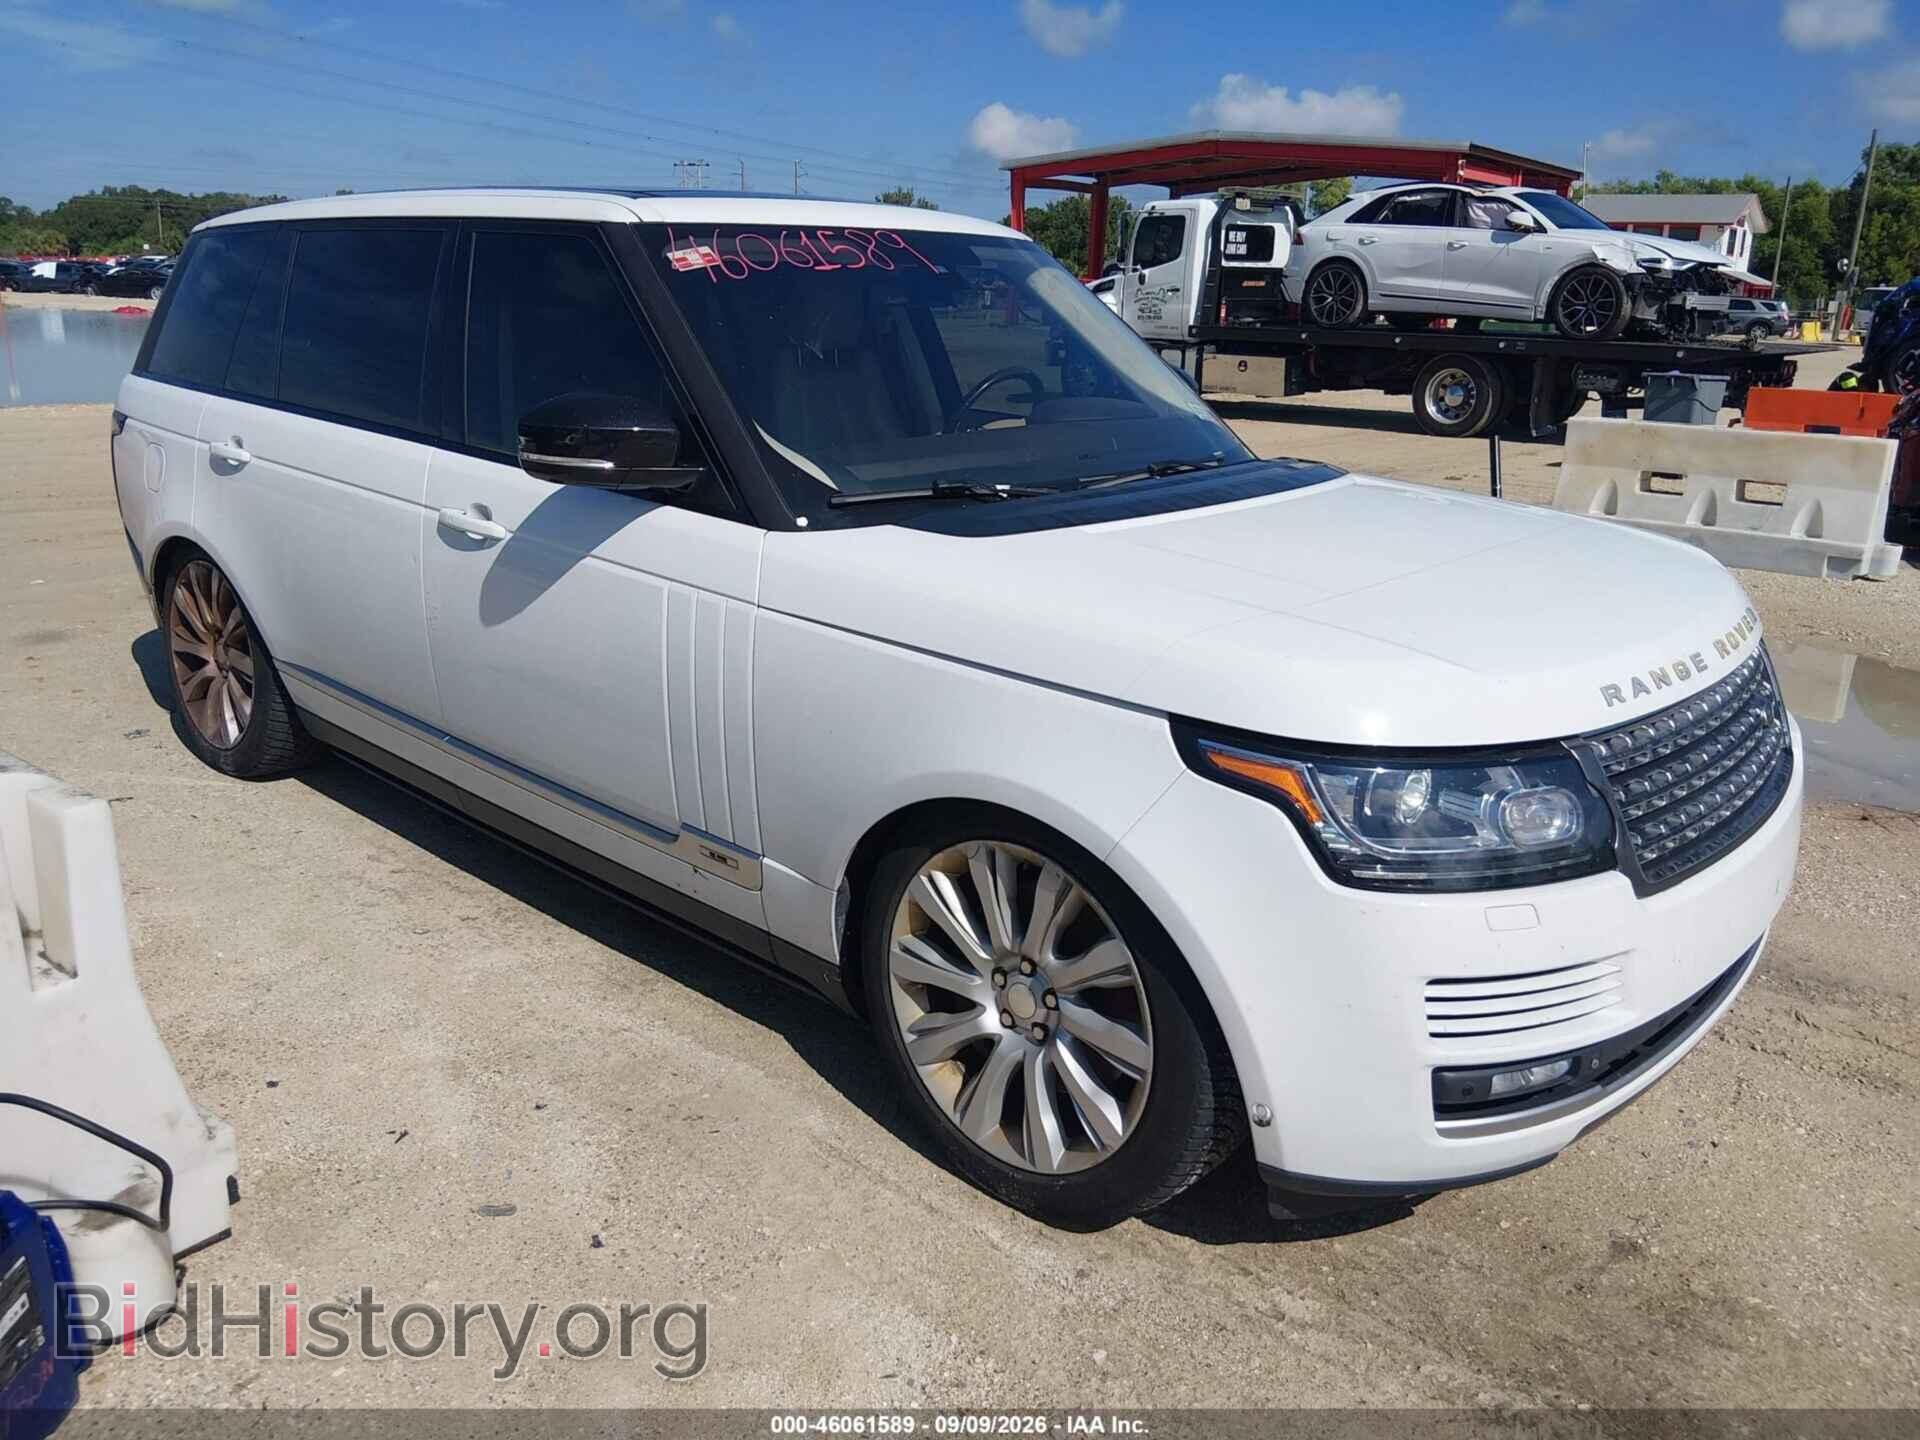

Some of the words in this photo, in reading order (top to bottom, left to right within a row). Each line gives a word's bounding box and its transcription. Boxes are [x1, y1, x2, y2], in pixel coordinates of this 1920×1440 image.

[667, 225, 940, 283] 46061589
[1599, 652, 1709, 708] RANGE
[1712, 607, 1758, 659] ROVER
